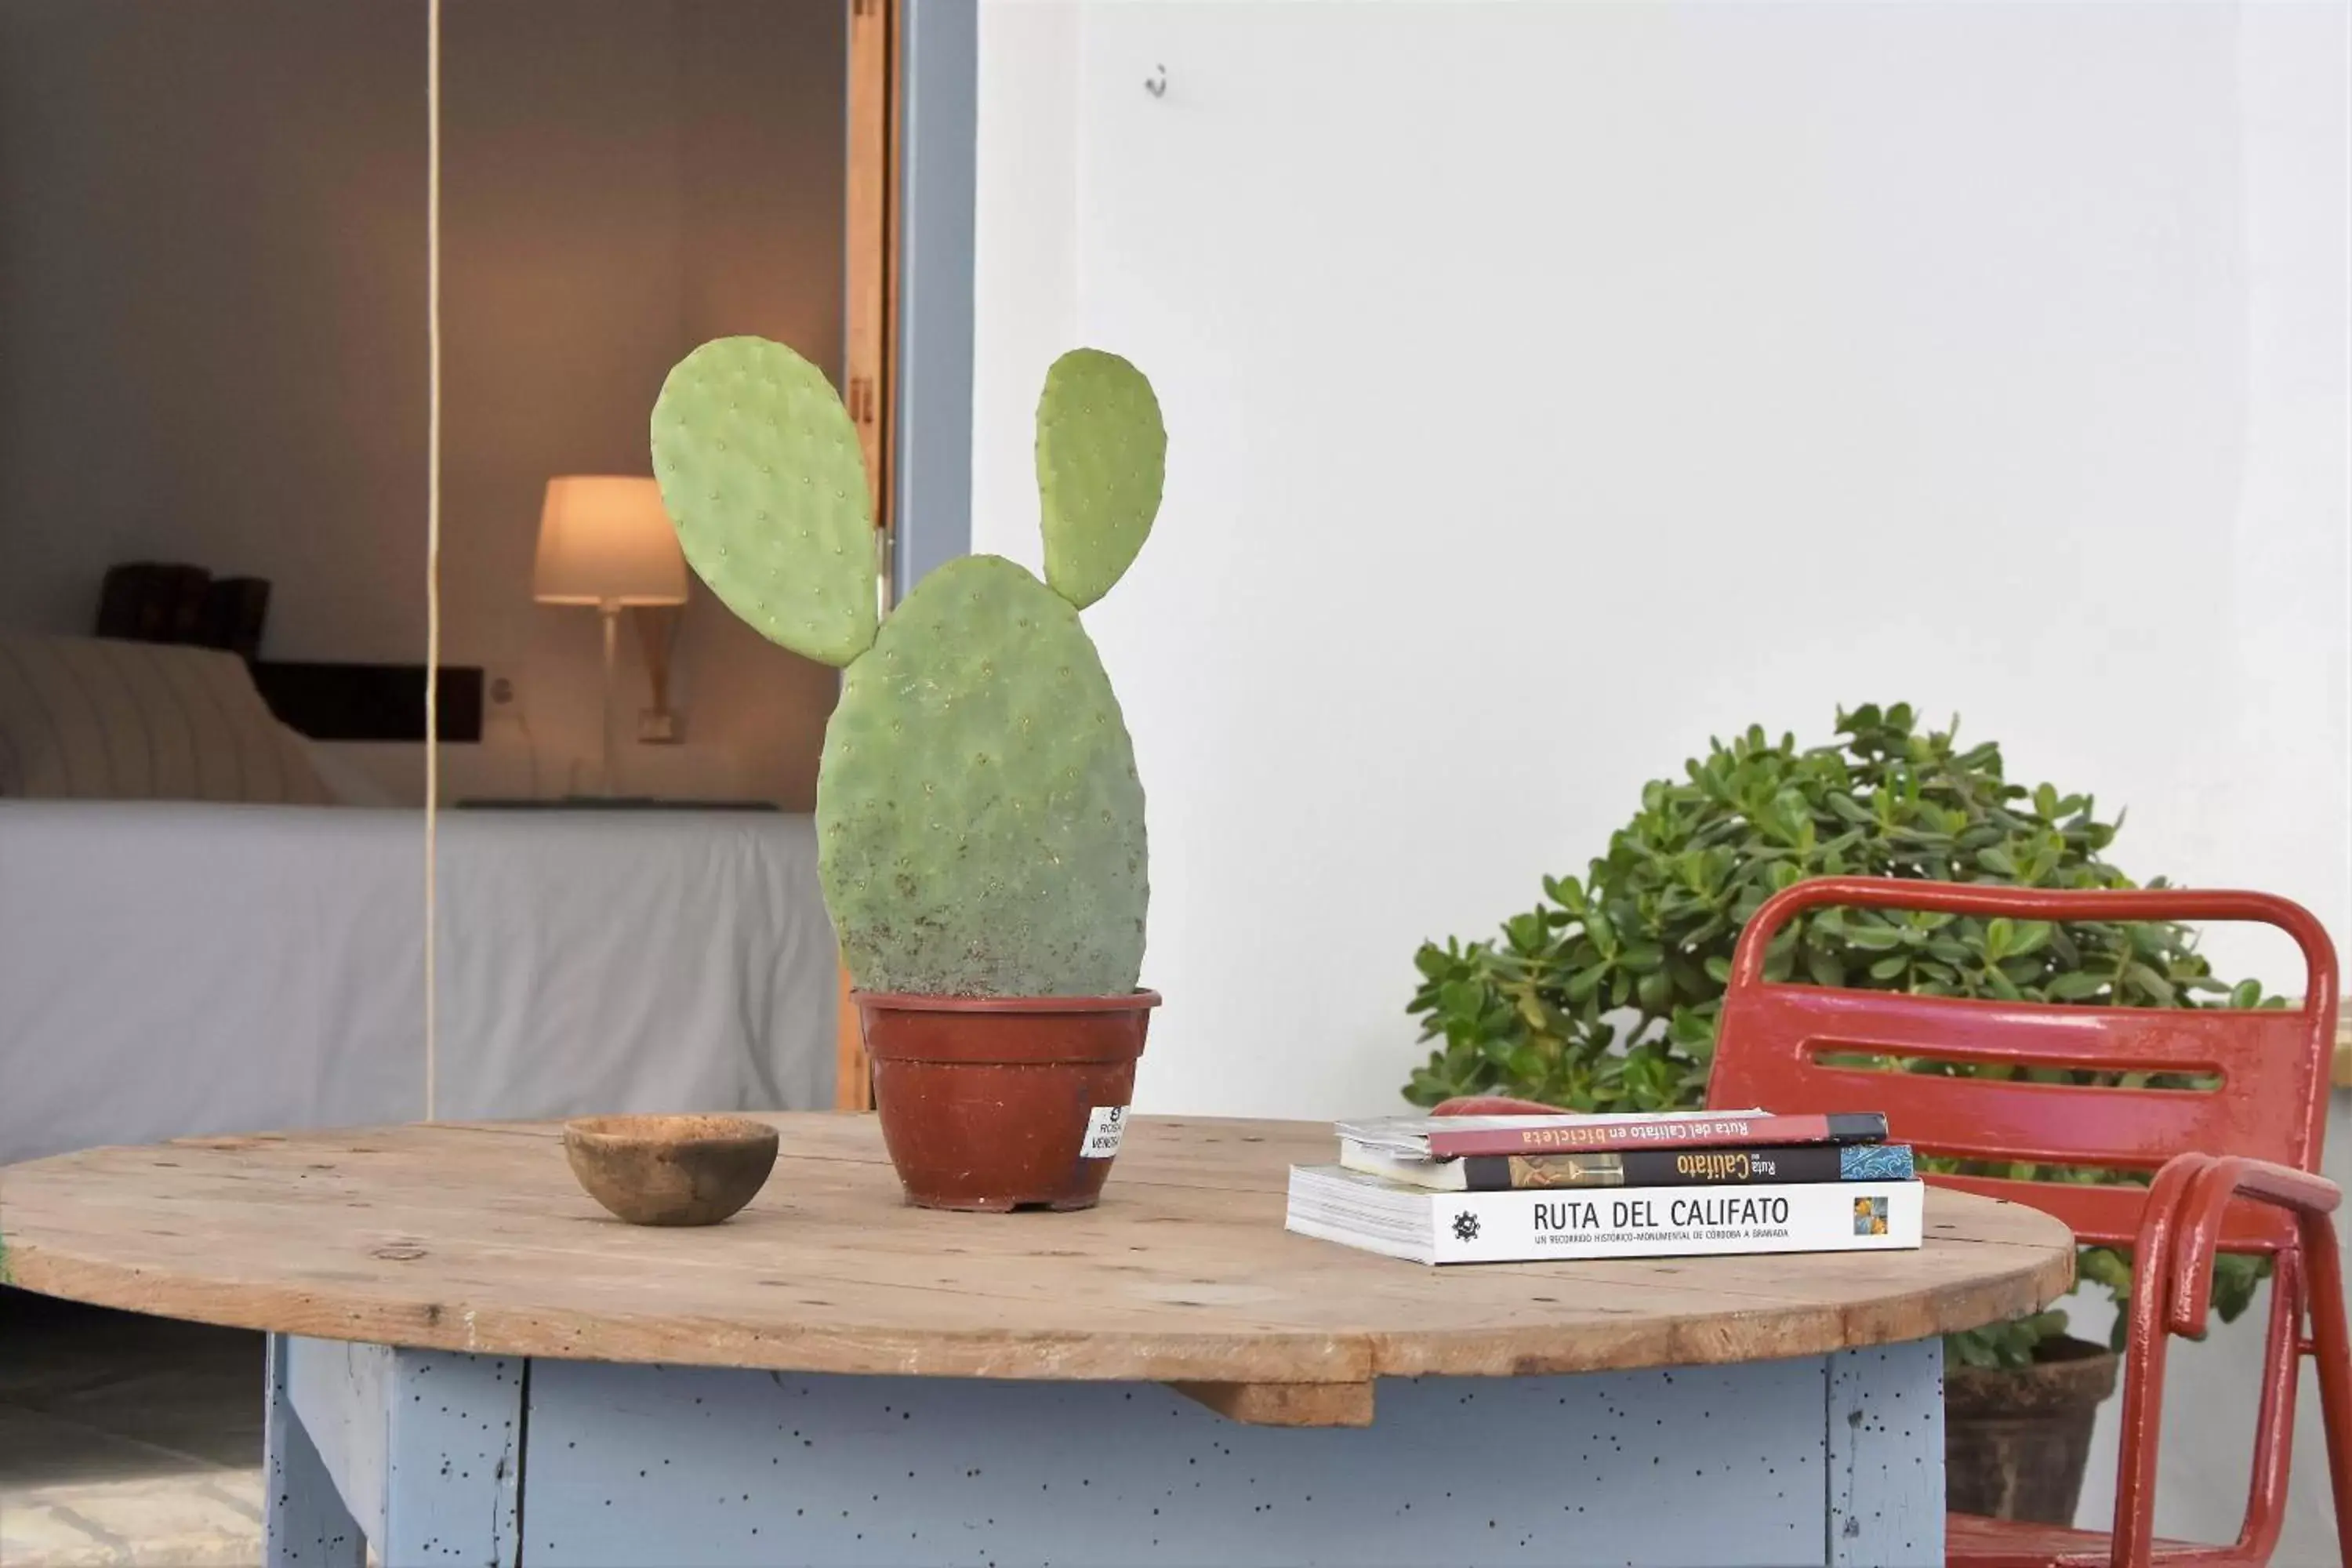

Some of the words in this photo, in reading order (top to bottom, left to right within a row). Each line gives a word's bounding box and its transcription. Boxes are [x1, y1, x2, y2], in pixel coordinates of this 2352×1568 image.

[1610, 1127, 1627, 1138] en
[1631, 1125, 1686, 1140] Califato
[1690, 1123, 1711, 1138] del
[1715, 1122, 1749, 1136] Ruta
[1522, 1128, 1606, 1146] bicicleta
[1677, 1154, 1749, 1179] Califato
[1751, 1160, 1776, 1175] Ruta
[1534, 1202, 1600, 1230] RUTA
[1613, 1200, 1659, 1229] DEL
[1671, 1197, 1789, 1226] CALIFATO
[1534, 1235, 1547, 1244] UN
[1549, 1233, 1592, 1243] RECORRIDO
[1693, 1230, 1703, 1240] DE
[1743, 1229, 1750, 1238] A
[1752, 1229, 1789, 1238] GRANADA
